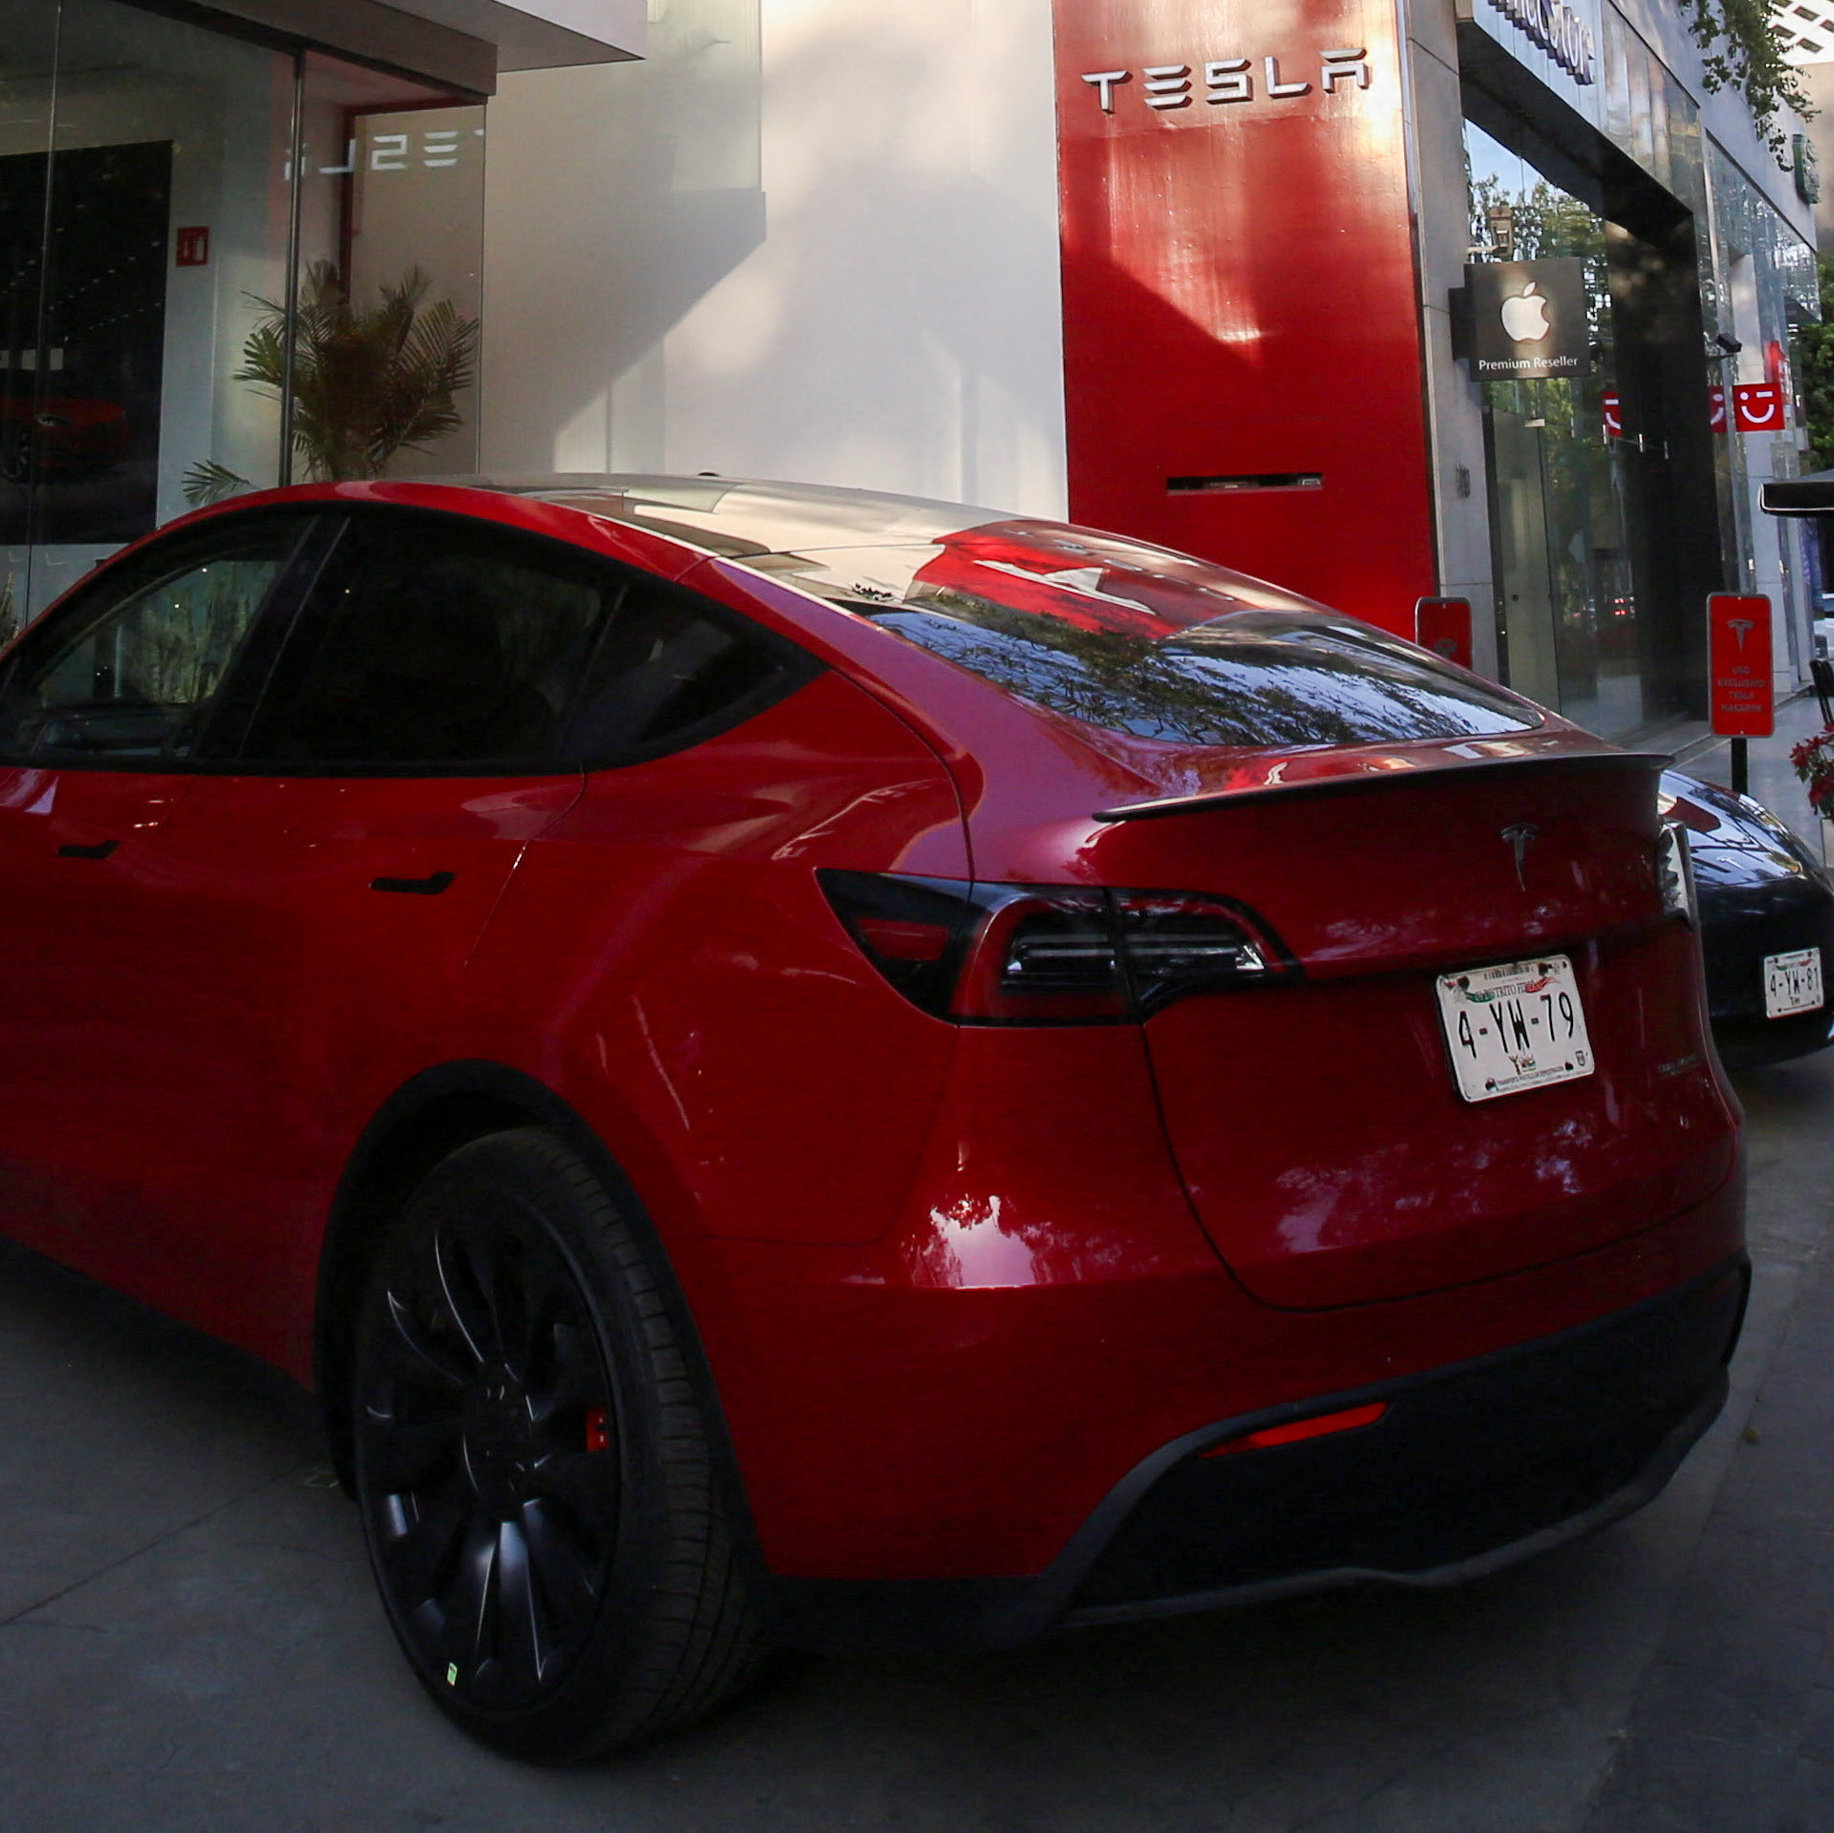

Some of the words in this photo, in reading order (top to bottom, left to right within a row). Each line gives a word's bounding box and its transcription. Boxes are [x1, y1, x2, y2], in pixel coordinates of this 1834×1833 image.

[1081, 48, 1370, 114] TESLA
[1478, 358, 1531, 370] Premium
[1533, 356, 1578, 367] Reseller
[1770, 967, 1819, 997] 4-YW-81
[1458, 992, 1575, 1059] 4-YW-79
